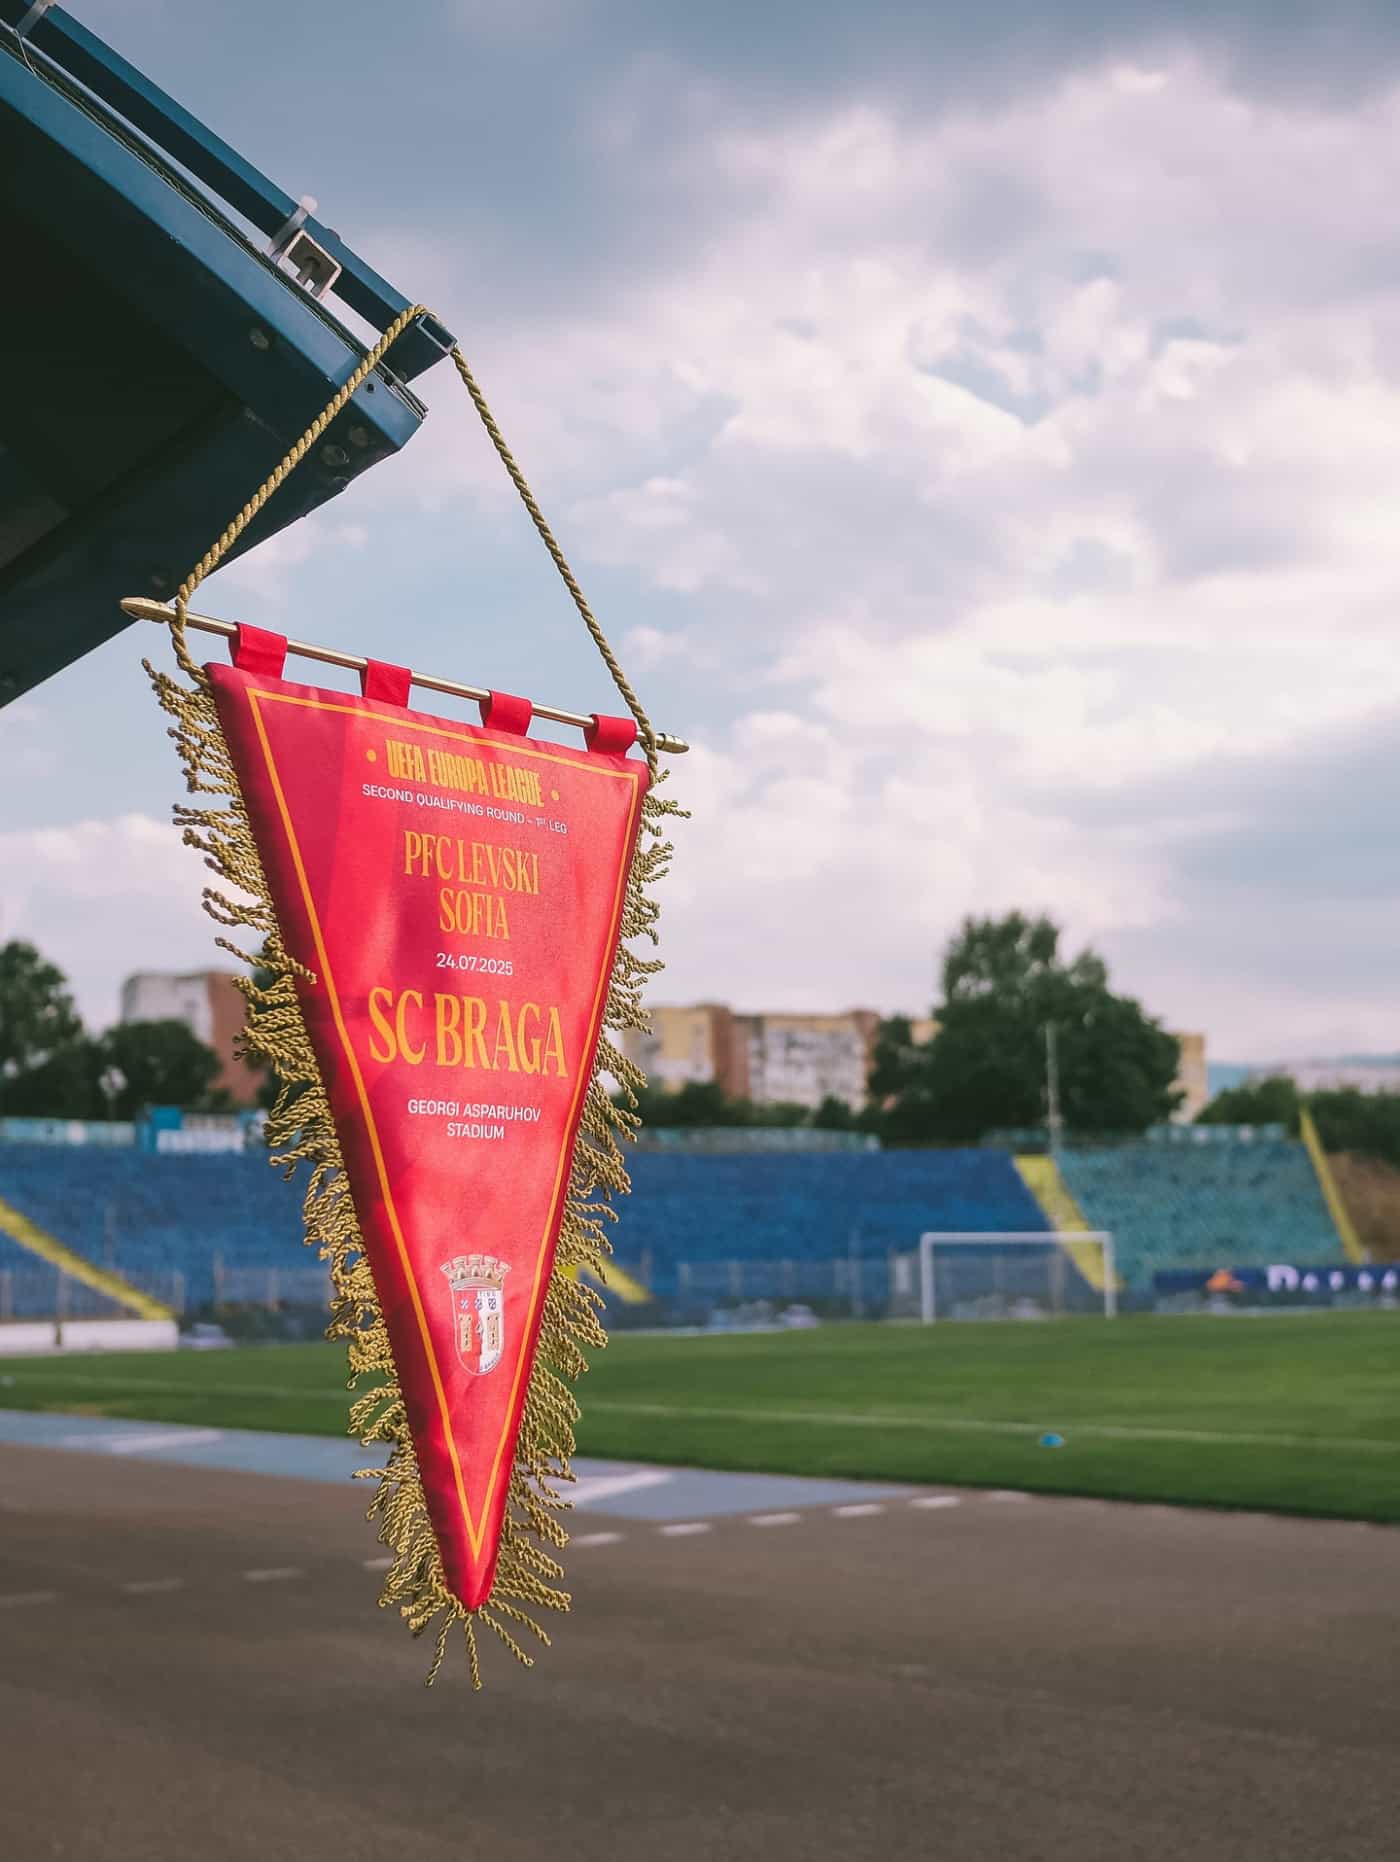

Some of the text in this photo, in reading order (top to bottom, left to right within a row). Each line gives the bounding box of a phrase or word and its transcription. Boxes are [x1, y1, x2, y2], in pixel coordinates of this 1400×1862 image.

[385, 739, 545, 808] UEFA EUROPA LEAGUE
[361, 783, 414, 803] SECOND
[416, 794, 484, 817] QUALIFYING
[486, 806, 525, 825] ROUND
[549, 820, 568, 834] LEG
[404, 830, 540, 895] PFC LEVSKI
[439, 887, 510, 940] SOFIA
[436, 952, 514, 976] 24.07.2025
[368, 986, 569, 1078] SC BRAGA
[407, 1099, 541, 1122] GEORGI ASPARUHOV
[447, 1121, 505, 1139] STADIUM
